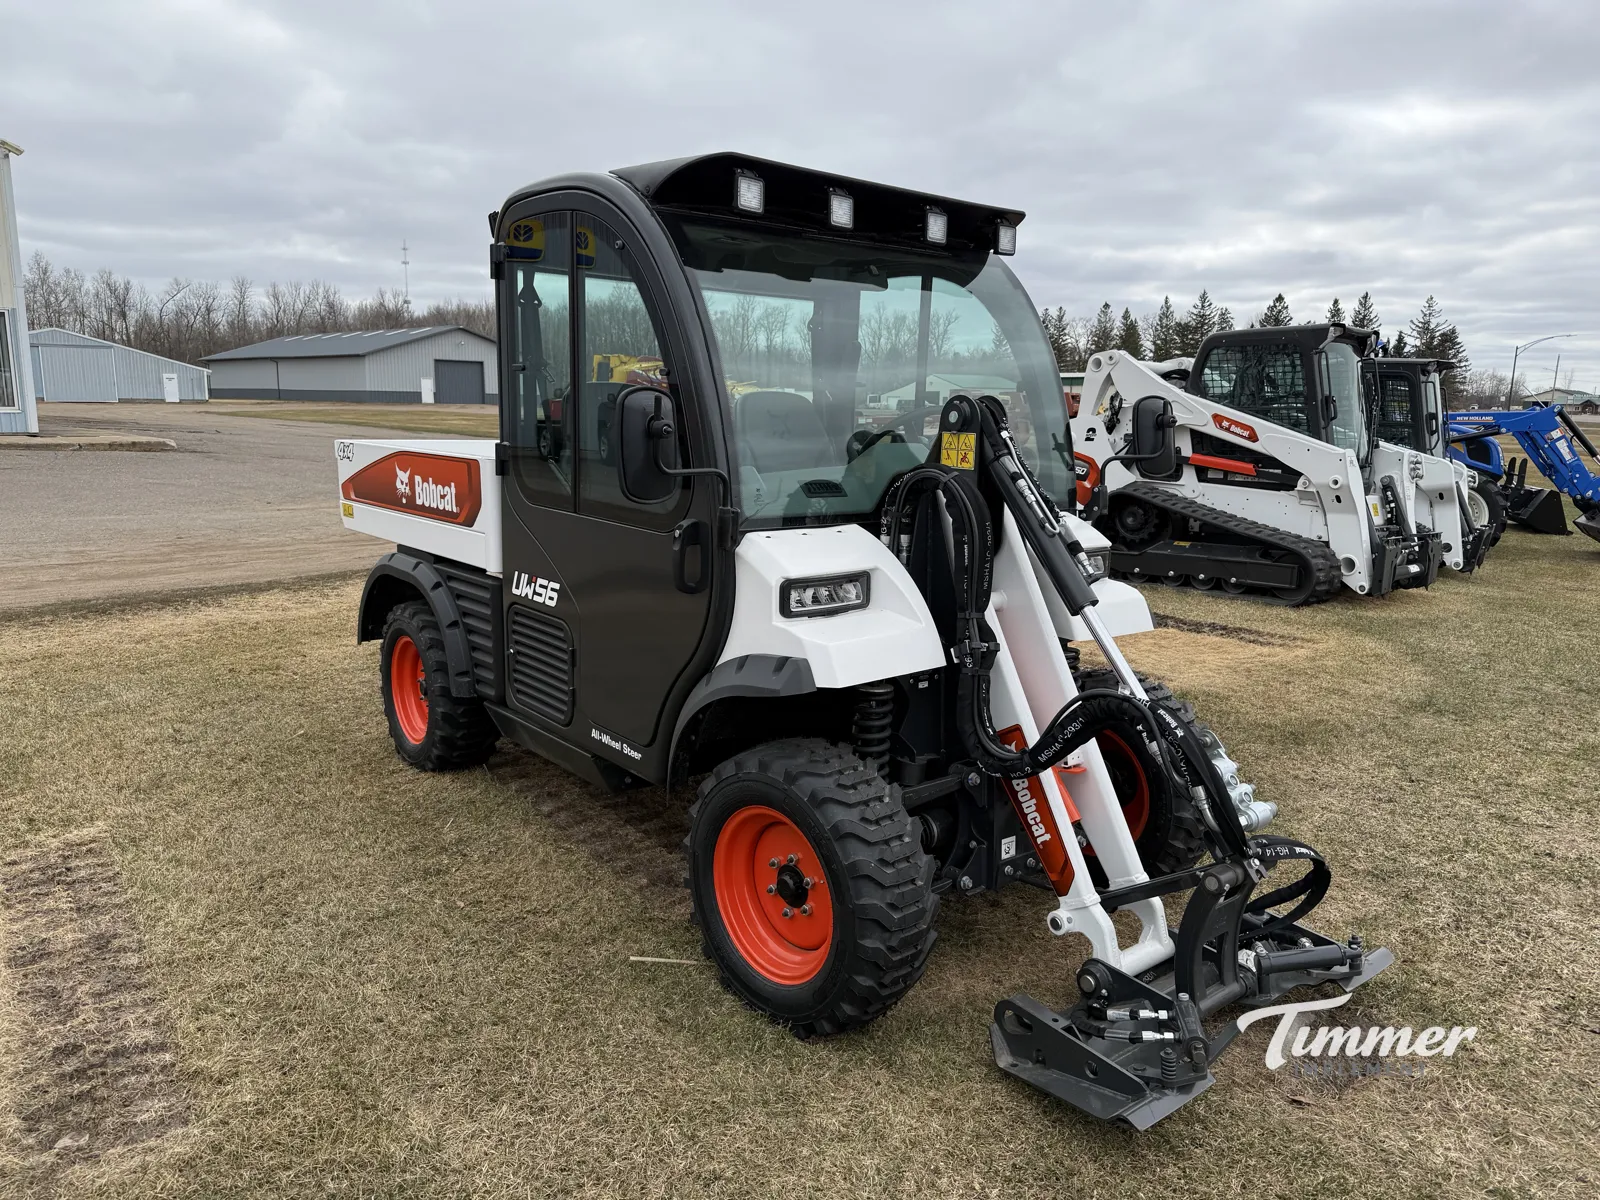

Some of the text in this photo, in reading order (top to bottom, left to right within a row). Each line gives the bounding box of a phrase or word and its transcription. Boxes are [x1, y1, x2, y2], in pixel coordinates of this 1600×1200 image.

[1229, 424, 1251, 438] Bobcat
[337, 441, 355, 462] 4x4
[1074, 466, 1087, 475] 50
[414, 474, 459, 513] Bobcat
[1157, 708, 1178, 728] Bobcat
[591, 728, 643, 761] All-Wheel Steer
[1037, 742, 1064, 763] MSHA
[1012, 778, 1051, 846] Bobcat
